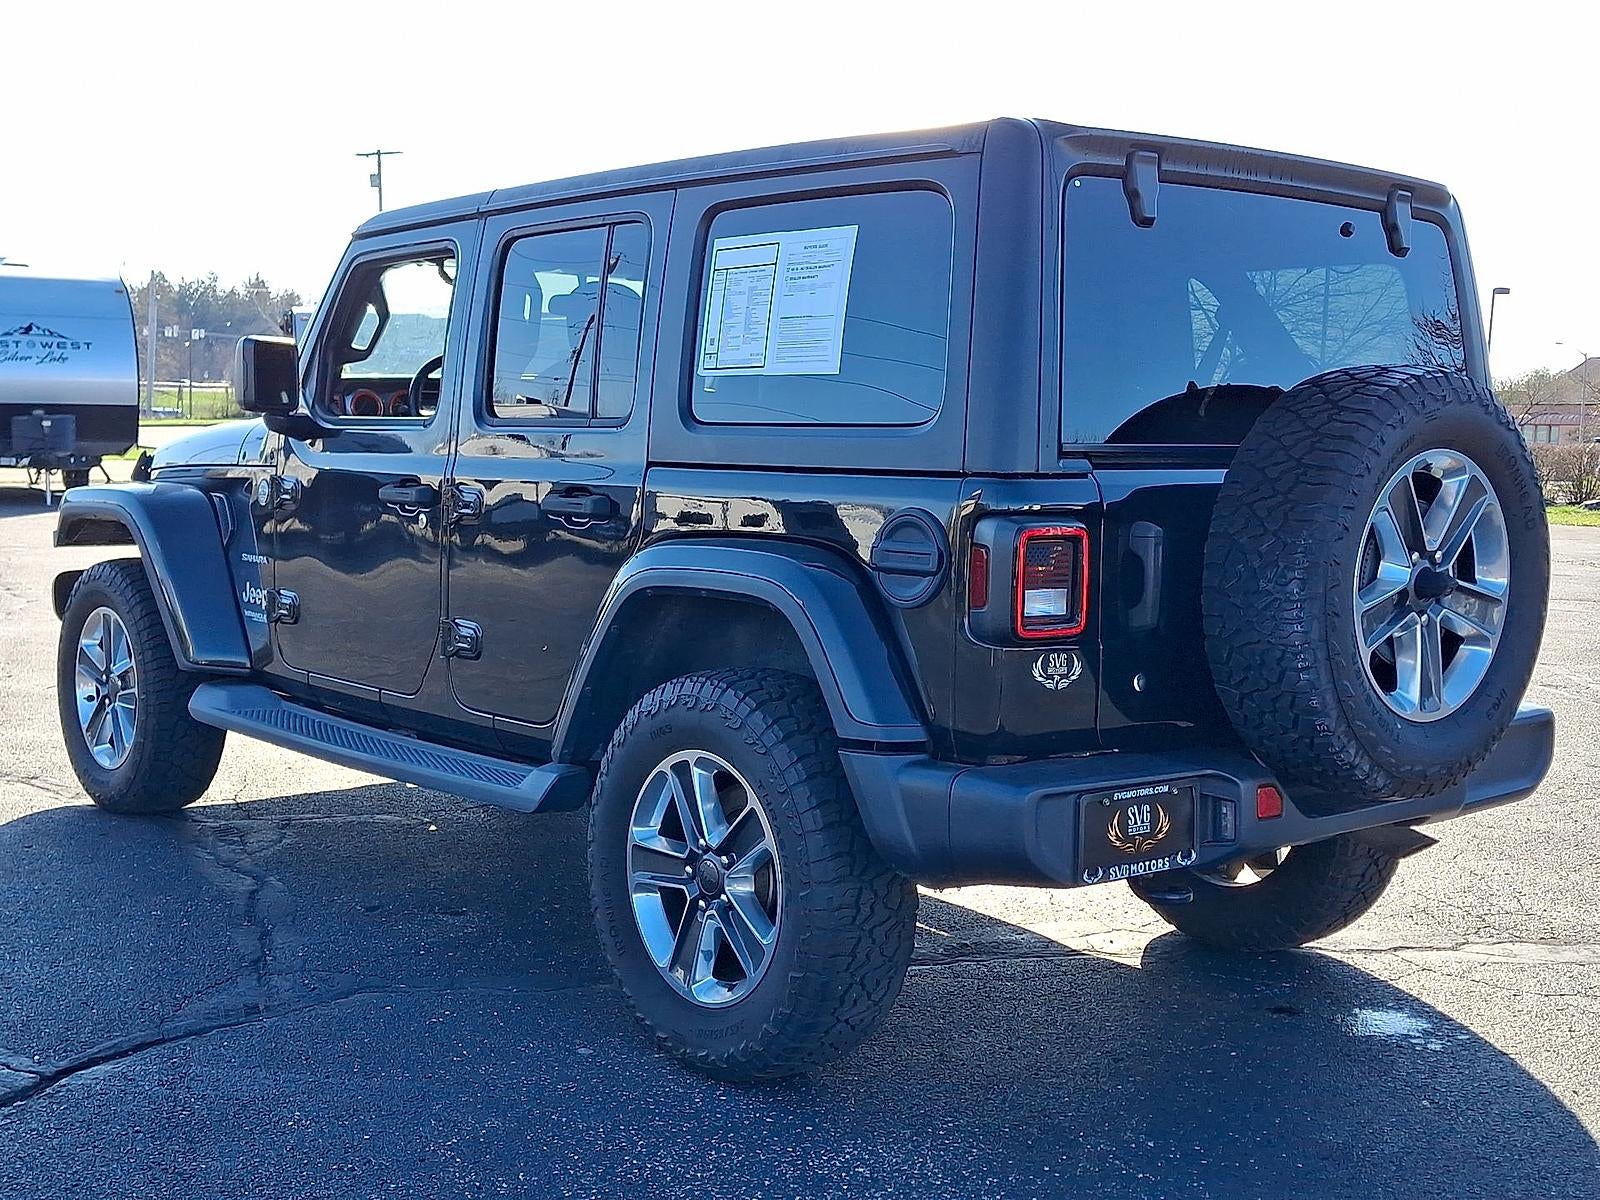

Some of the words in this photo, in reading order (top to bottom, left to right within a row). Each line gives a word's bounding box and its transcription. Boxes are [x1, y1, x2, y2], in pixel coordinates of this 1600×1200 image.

[40, 341, 93, 351] WEST
[36, 350, 69, 365] Lake
[241, 553, 268, 565] SAHARA
[242, 581, 268, 610] Jeep
[1049, 652, 1068, 668] SVG
[1113, 785, 1169, 801] SVGMOTORS.COM
[1127, 804, 1151, 826] SVG
[1128, 826, 1151, 834] MOTORS
[1130, 857, 1170, 874] MOTORS
